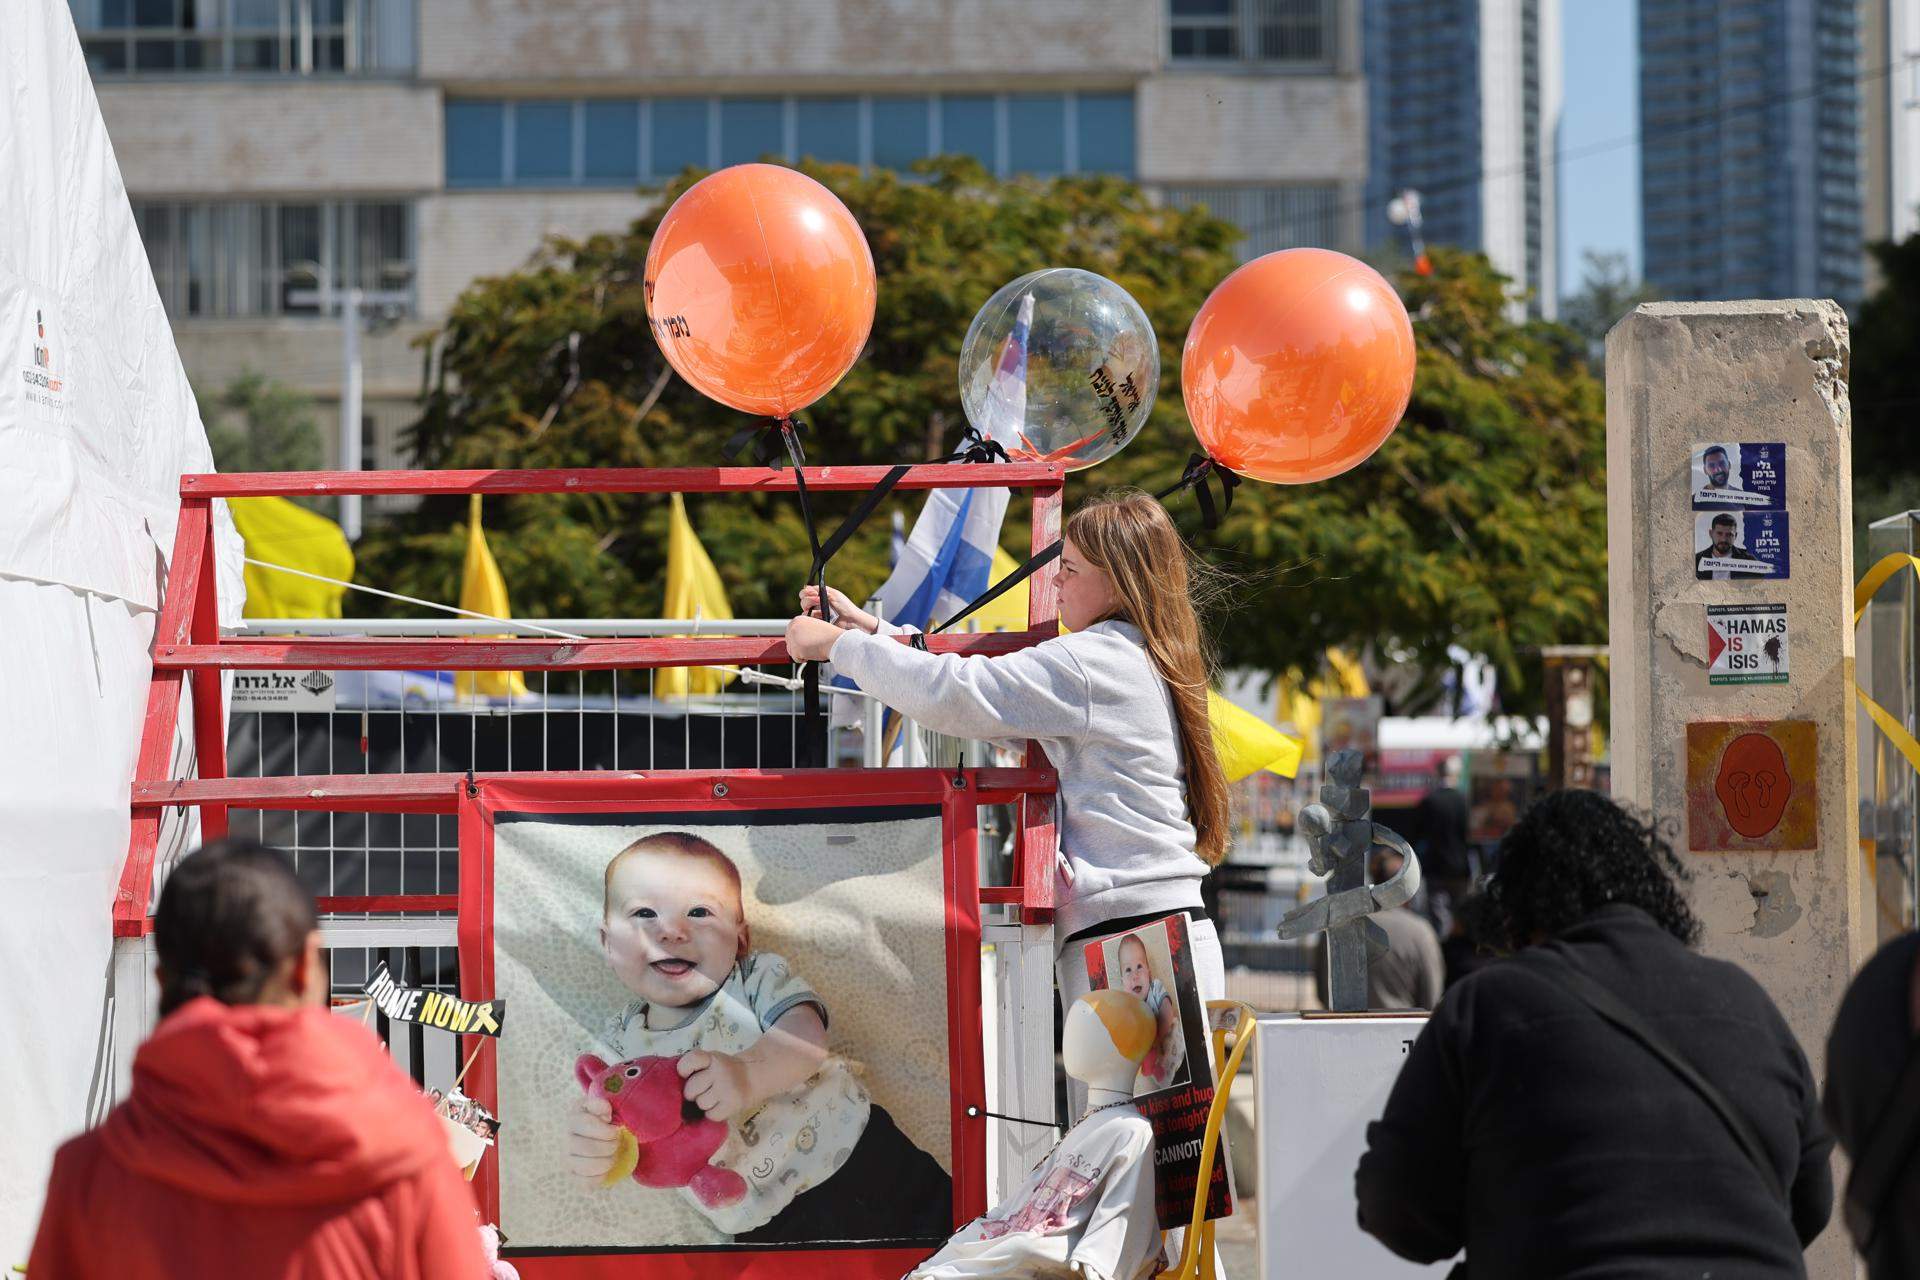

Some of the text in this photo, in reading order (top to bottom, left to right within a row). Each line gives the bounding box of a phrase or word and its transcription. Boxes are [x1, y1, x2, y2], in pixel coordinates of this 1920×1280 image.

[1757, 460, 1771, 470] גלי
[1752, 470, 1776, 479] ברמן
[1761, 530, 1774, 538] זיו
[1755, 538, 1780, 547] ברמן
[1728, 619, 1786, 634] HAMAS
[1728, 637, 1743, 652] IS
[1729, 654, 1758, 669] ISIS
[234, 672, 296, 688] אל גדרו
[367, 967, 477, 1032] HOME NOW
[1148, 1098, 1169, 1115] kiss
[1171, 1088, 1192, 1110] and
[1192, 1087, 1214, 1105] hug
[1154, 1139, 1202, 1165] CANNOT!
